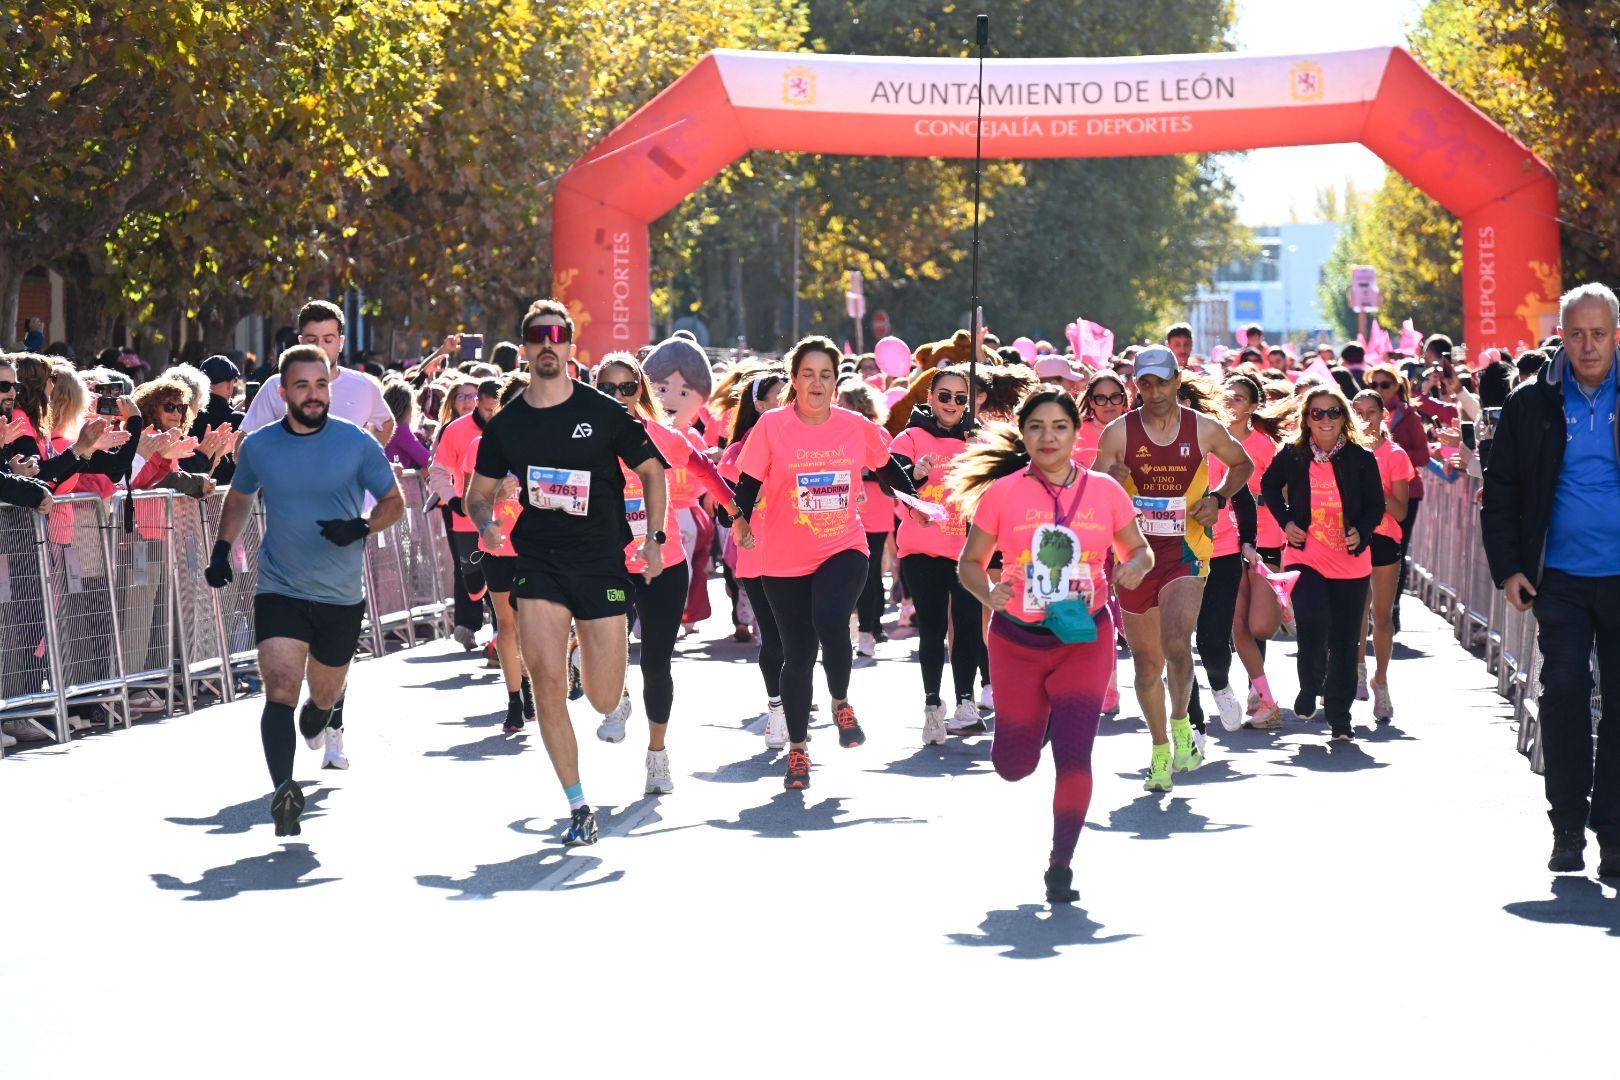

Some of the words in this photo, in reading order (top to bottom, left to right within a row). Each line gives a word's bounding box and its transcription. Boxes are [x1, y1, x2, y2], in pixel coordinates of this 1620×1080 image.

[871, 81, 1104, 105] AYUNTAMIENTO
[1114, 80, 1150, 103] DE
[1161, 72, 1235, 102] LEÓN
[914, 116, 1044, 138] CONCEJALÍA
[1050, 119, 1080, 137] DE
[1086, 115, 1194, 136] DEPORTES
[612, 232, 631, 340] DEPORTES
[1478, 225, 1497, 335] DEPORTES
[549, 483, 578, 496] 4763
[812, 485, 850, 495] MADRINA
[1158, 483, 1182, 491] TORO
[1151, 511, 1176, 520] 1092
